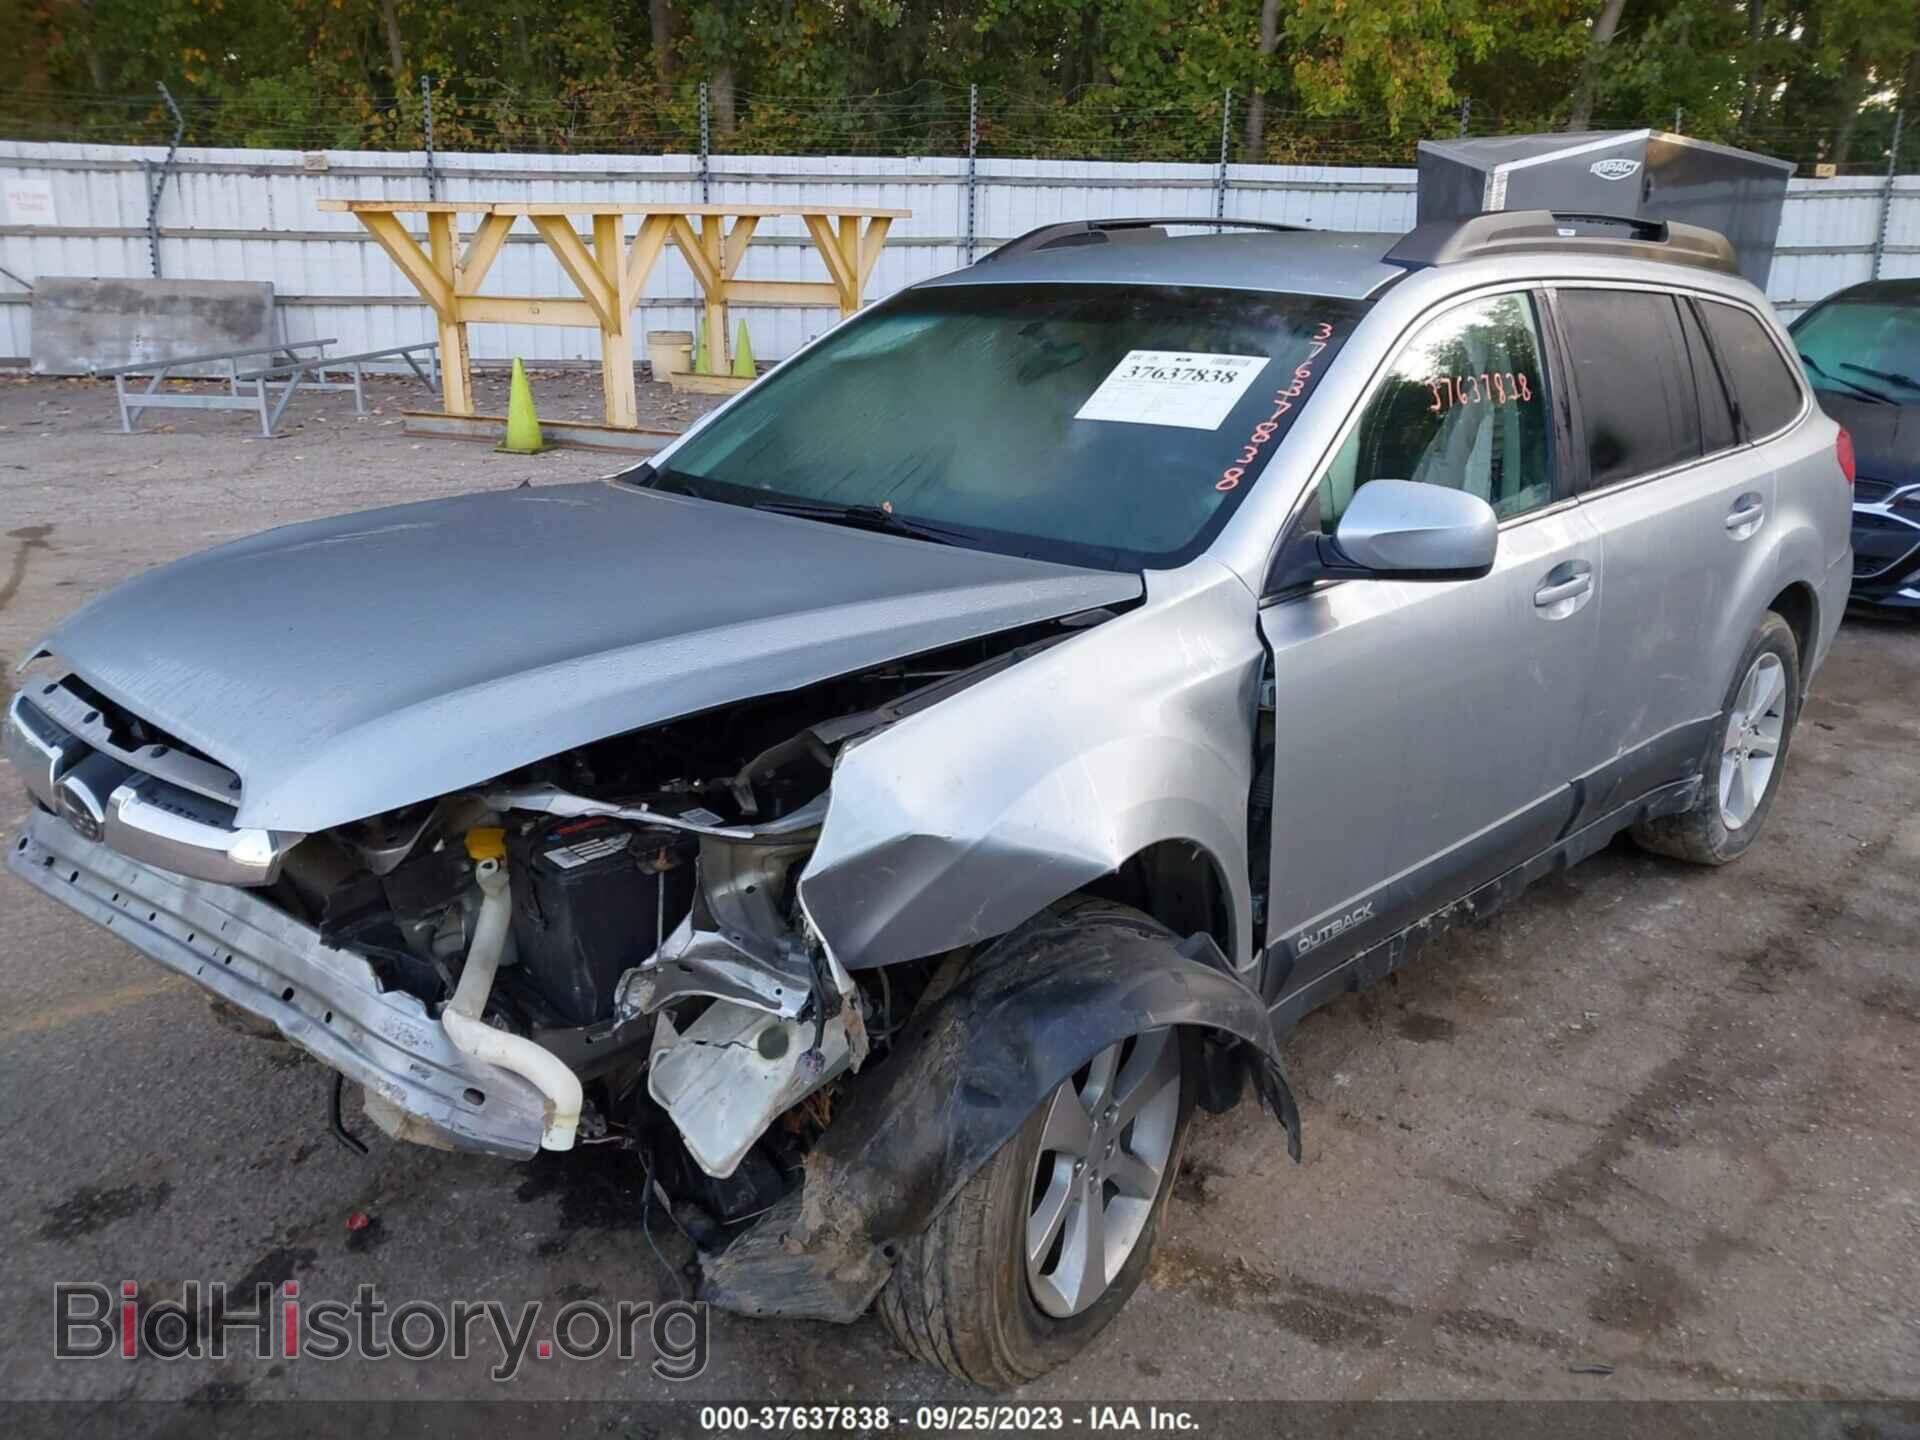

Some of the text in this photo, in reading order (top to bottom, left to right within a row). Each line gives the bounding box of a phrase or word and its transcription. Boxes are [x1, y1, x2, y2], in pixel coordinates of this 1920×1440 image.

[1122, 365, 1238, 384] 37637838
[1424, 372, 1532, 411] 37637838
[1215, 323, 1333, 491] 37637838
[1297, 901, 1375, 953] OUTBACK
